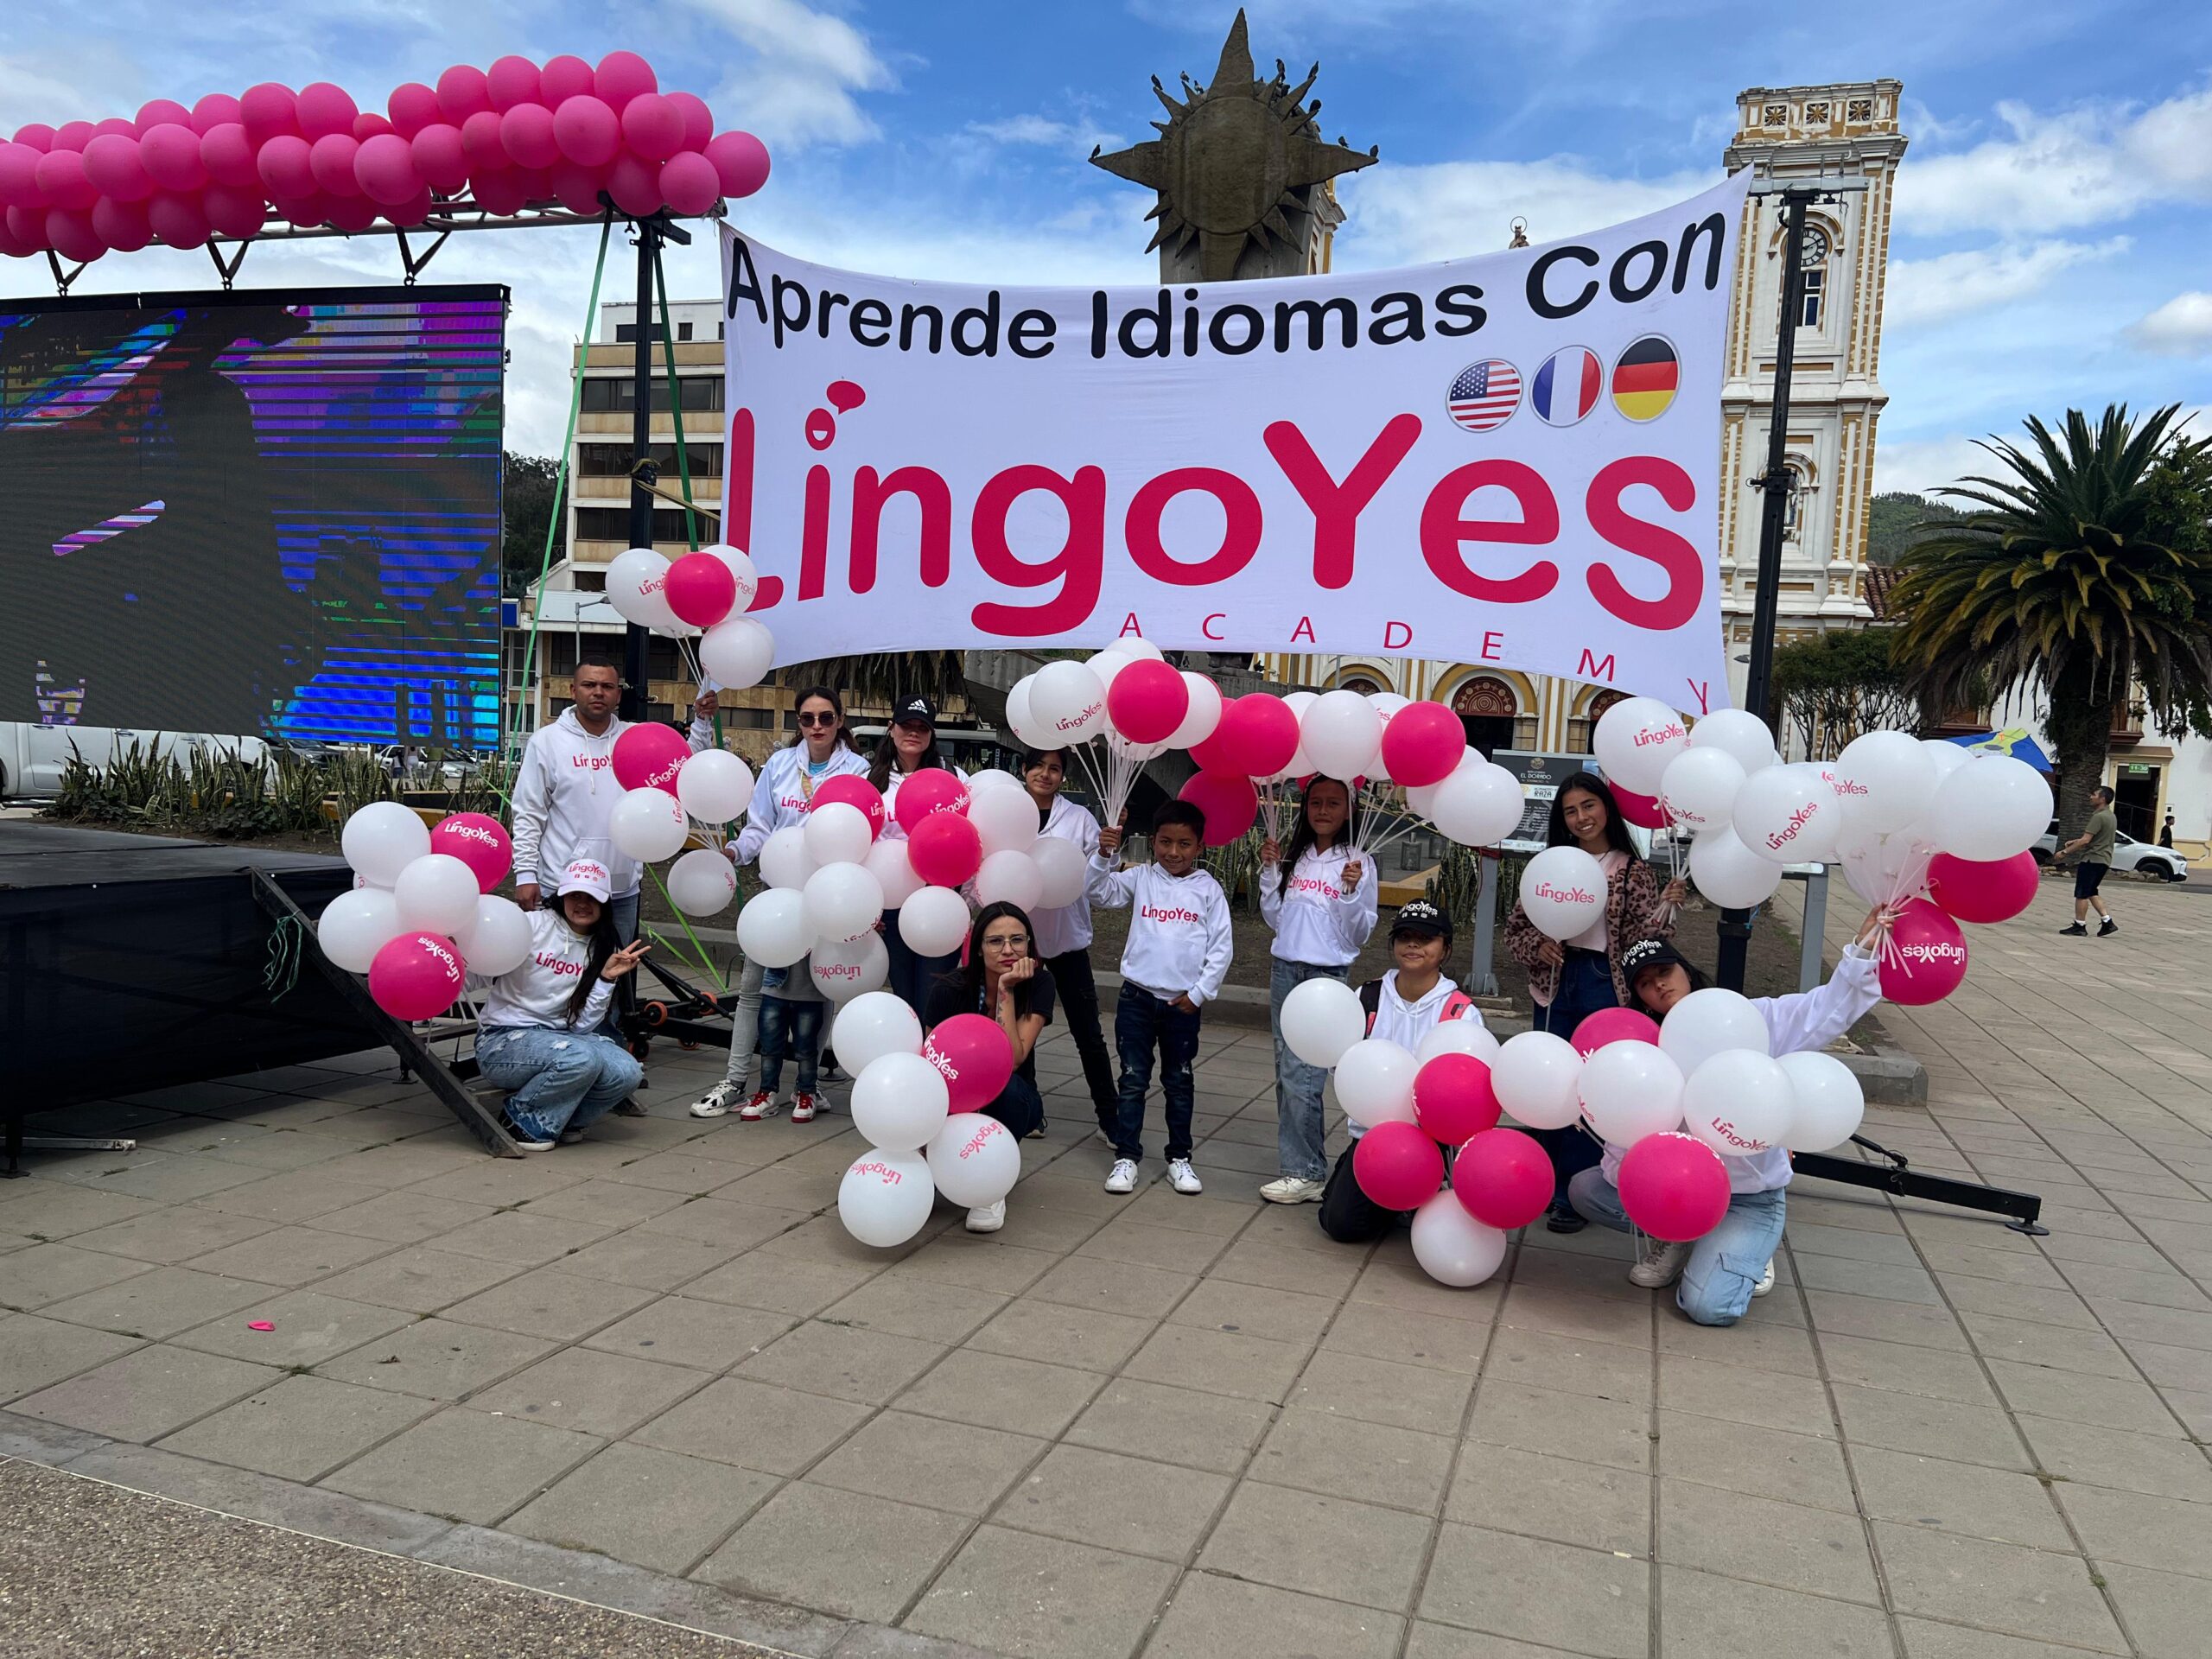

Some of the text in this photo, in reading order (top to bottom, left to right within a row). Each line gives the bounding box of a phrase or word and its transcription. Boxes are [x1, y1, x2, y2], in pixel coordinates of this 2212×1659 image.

[727, 212, 1726, 359] Aprende Idiomas Con
[728, 406, 1705, 638] LingoYes
[1119, 611, 1708, 715] ACADEMY
[908, 705, 928, 715] adidas
[1055, 701, 1102, 731] LingoYes
[1633, 723, 1685, 747] LingoYes
[1834, 779, 1868, 796] goYes
[444, 821, 499, 848] LingoYes
[1765, 802, 1817, 850] LingoYes
[569, 862, 607, 879] LingoYes
[1535, 882, 1595, 904] LingoYes
[1141, 904, 1198, 923] LingoYes
[417, 936, 461, 983] LingoYes
[1902, 942, 1965, 965] LingoYes
[813, 963, 861, 980] LingoYes
